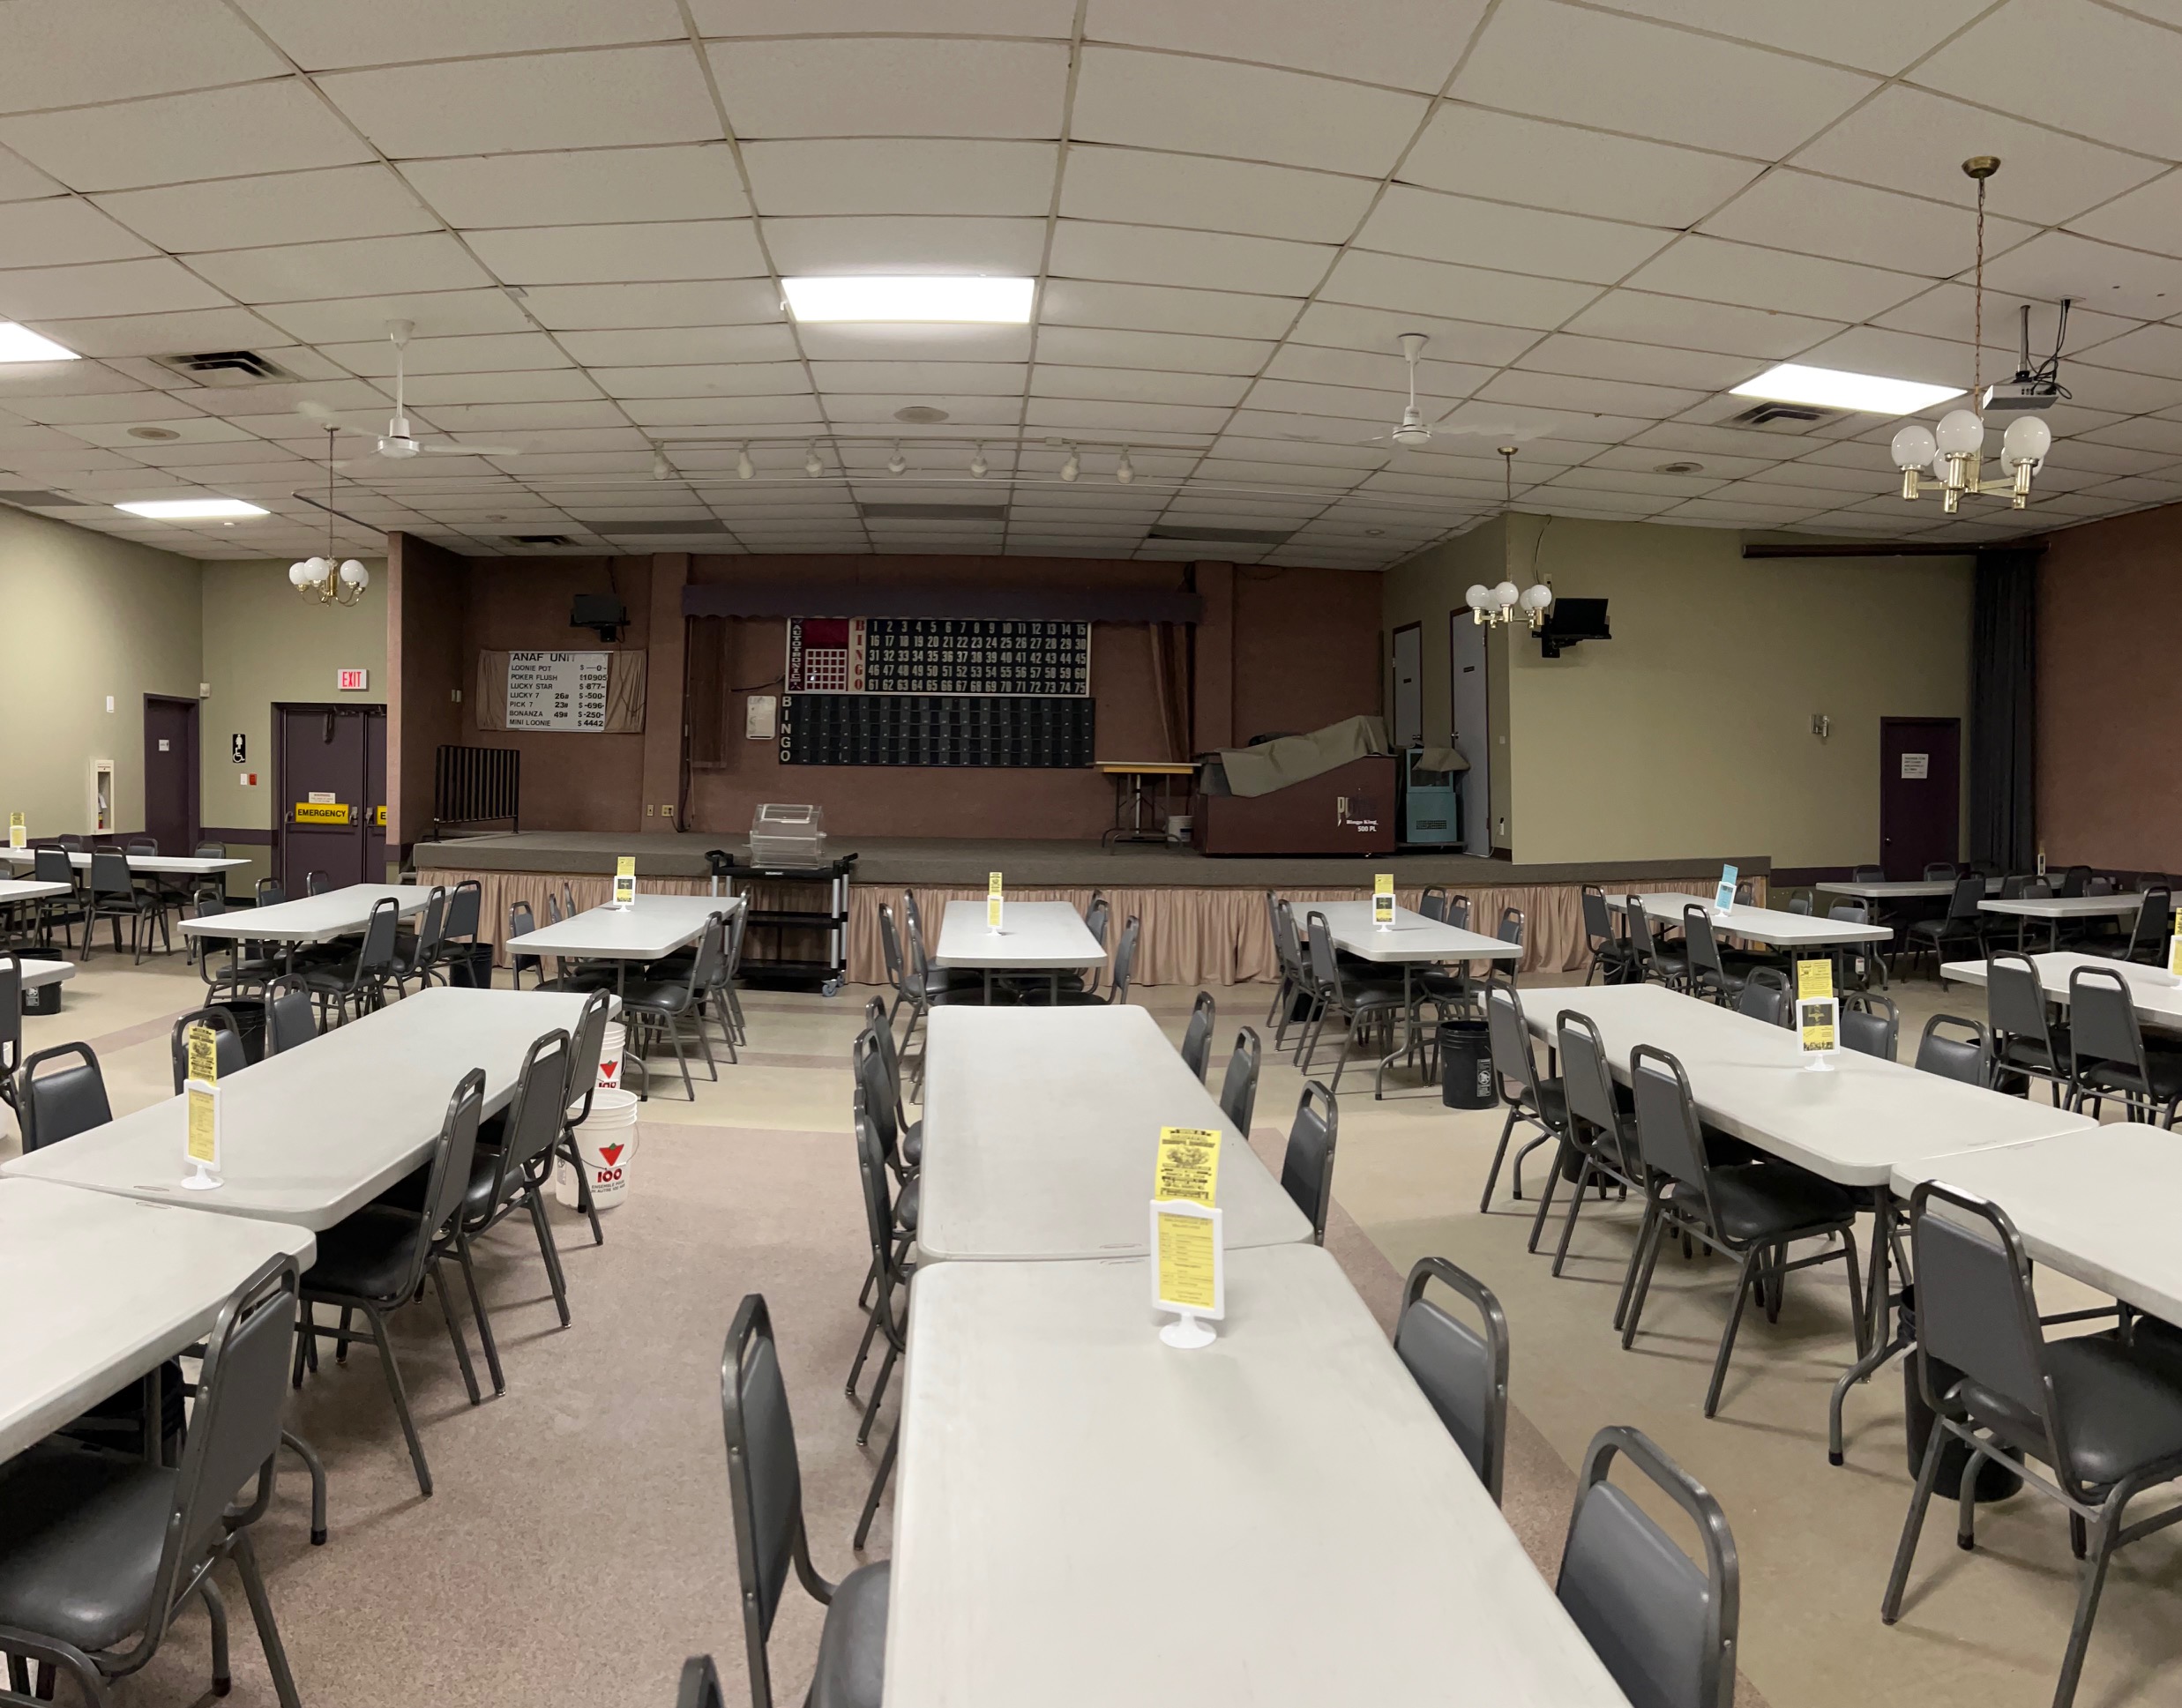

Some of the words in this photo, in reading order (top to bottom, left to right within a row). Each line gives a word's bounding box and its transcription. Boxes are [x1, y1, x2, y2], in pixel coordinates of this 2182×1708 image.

[874, 621, 878, 632] 1
[886, 621, 893, 632] 2
[901, 621, 908, 632] 3
[915, 622, 922, 632] 4
[930, 622, 937, 633] 5
[945, 622, 952, 633] 6
[960, 622, 966, 633] 7
[989, 623, 995, 634] 9
[1018, 623, 1026, 634] 11
[1032, 623, 1042, 635] 12
[1047, 623, 1057, 635] 13
[1061, 623, 1071, 635] 14
[1077, 624, 1086, 635] 15
[871, 635, 879, 646] 16
[885, 635, 894, 646] 17
[914, 636, 923, 647] 19
[927, 636, 939, 647] 20
[943, 636, 953, 648] 21
[957, 637, 968, 648] 22
[971, 637, 983, 648] 23
[985, 637, 998, 649] 24
[1000, 637, 1012, 649] 25
[1015, 637, 1027, 649] 26
[1030, 638, 1042, 649] 27
[1060, 638, 1072, 650] 29
[1075, 638, 1087, 650] 30
[512, 653, 544, 661] ANAF
[869, 649, 879, 661] 31
[883, 650, 894, 661] 32
[898, 650, 909, 661] 33
[912, 650, 923, 661] 34
[927, 650, 938, 662] 35
[942, 651, 953, 662] 36
[957, 651, 968, 662] 37
[985, 652, 998, 663] 39
[1000, 652, 1013, 663] 40
[1015, 652, 1027, 663] 41
[1030, 653, 1042, 664] 42
[1045, 653, 1057, 664] 43
[1060, 653, 1072, 664] 44
[1075, 653, 1087, 665] 45
[868, 664, 879, 676] 46
[883, 664, 894, 675] 47
[912, 665, 923, 676] 49
[926, 665, 938, 677] 50
[942, 665, 953, 677] 51
[956, 666, 968, 677] 52
[970, 666, 983, 678] 53
[985, 666, 997, 678] 54
[1000, 666, 1012, 678] 55
[1015, 666, 1027, 678] 56
[1030, 667, 1042, 678] 57
[1059, 667, 1072, 679] 59
[342, 671, 362, 688] EXIT
[869, 679, 878, 690] 61
[882, 679, 893, 690] 62
[897, 679, 908, 690] 63
[911, 679, 923, 690] 64
[926, 680, 938, 691] 65
[941, 680, 953, 691] 66
[955, 680, 968, 691] 67
[970, 681, 982, 692] 68
[985, 681, 997, 692] 69
[1000, 681, 1012, 692] 70
[1016, 681, 1026, 692] 71
[1029, 681, 1041, 693] 72
[1044, 682, 1056, 693] 73
[1059, 682, 1071, 693] 74
[1074, 682, 1086, 694] 75
[297, 809, 347, 818] EMERGENCY
[597, 1168, 622, 1182] 100
